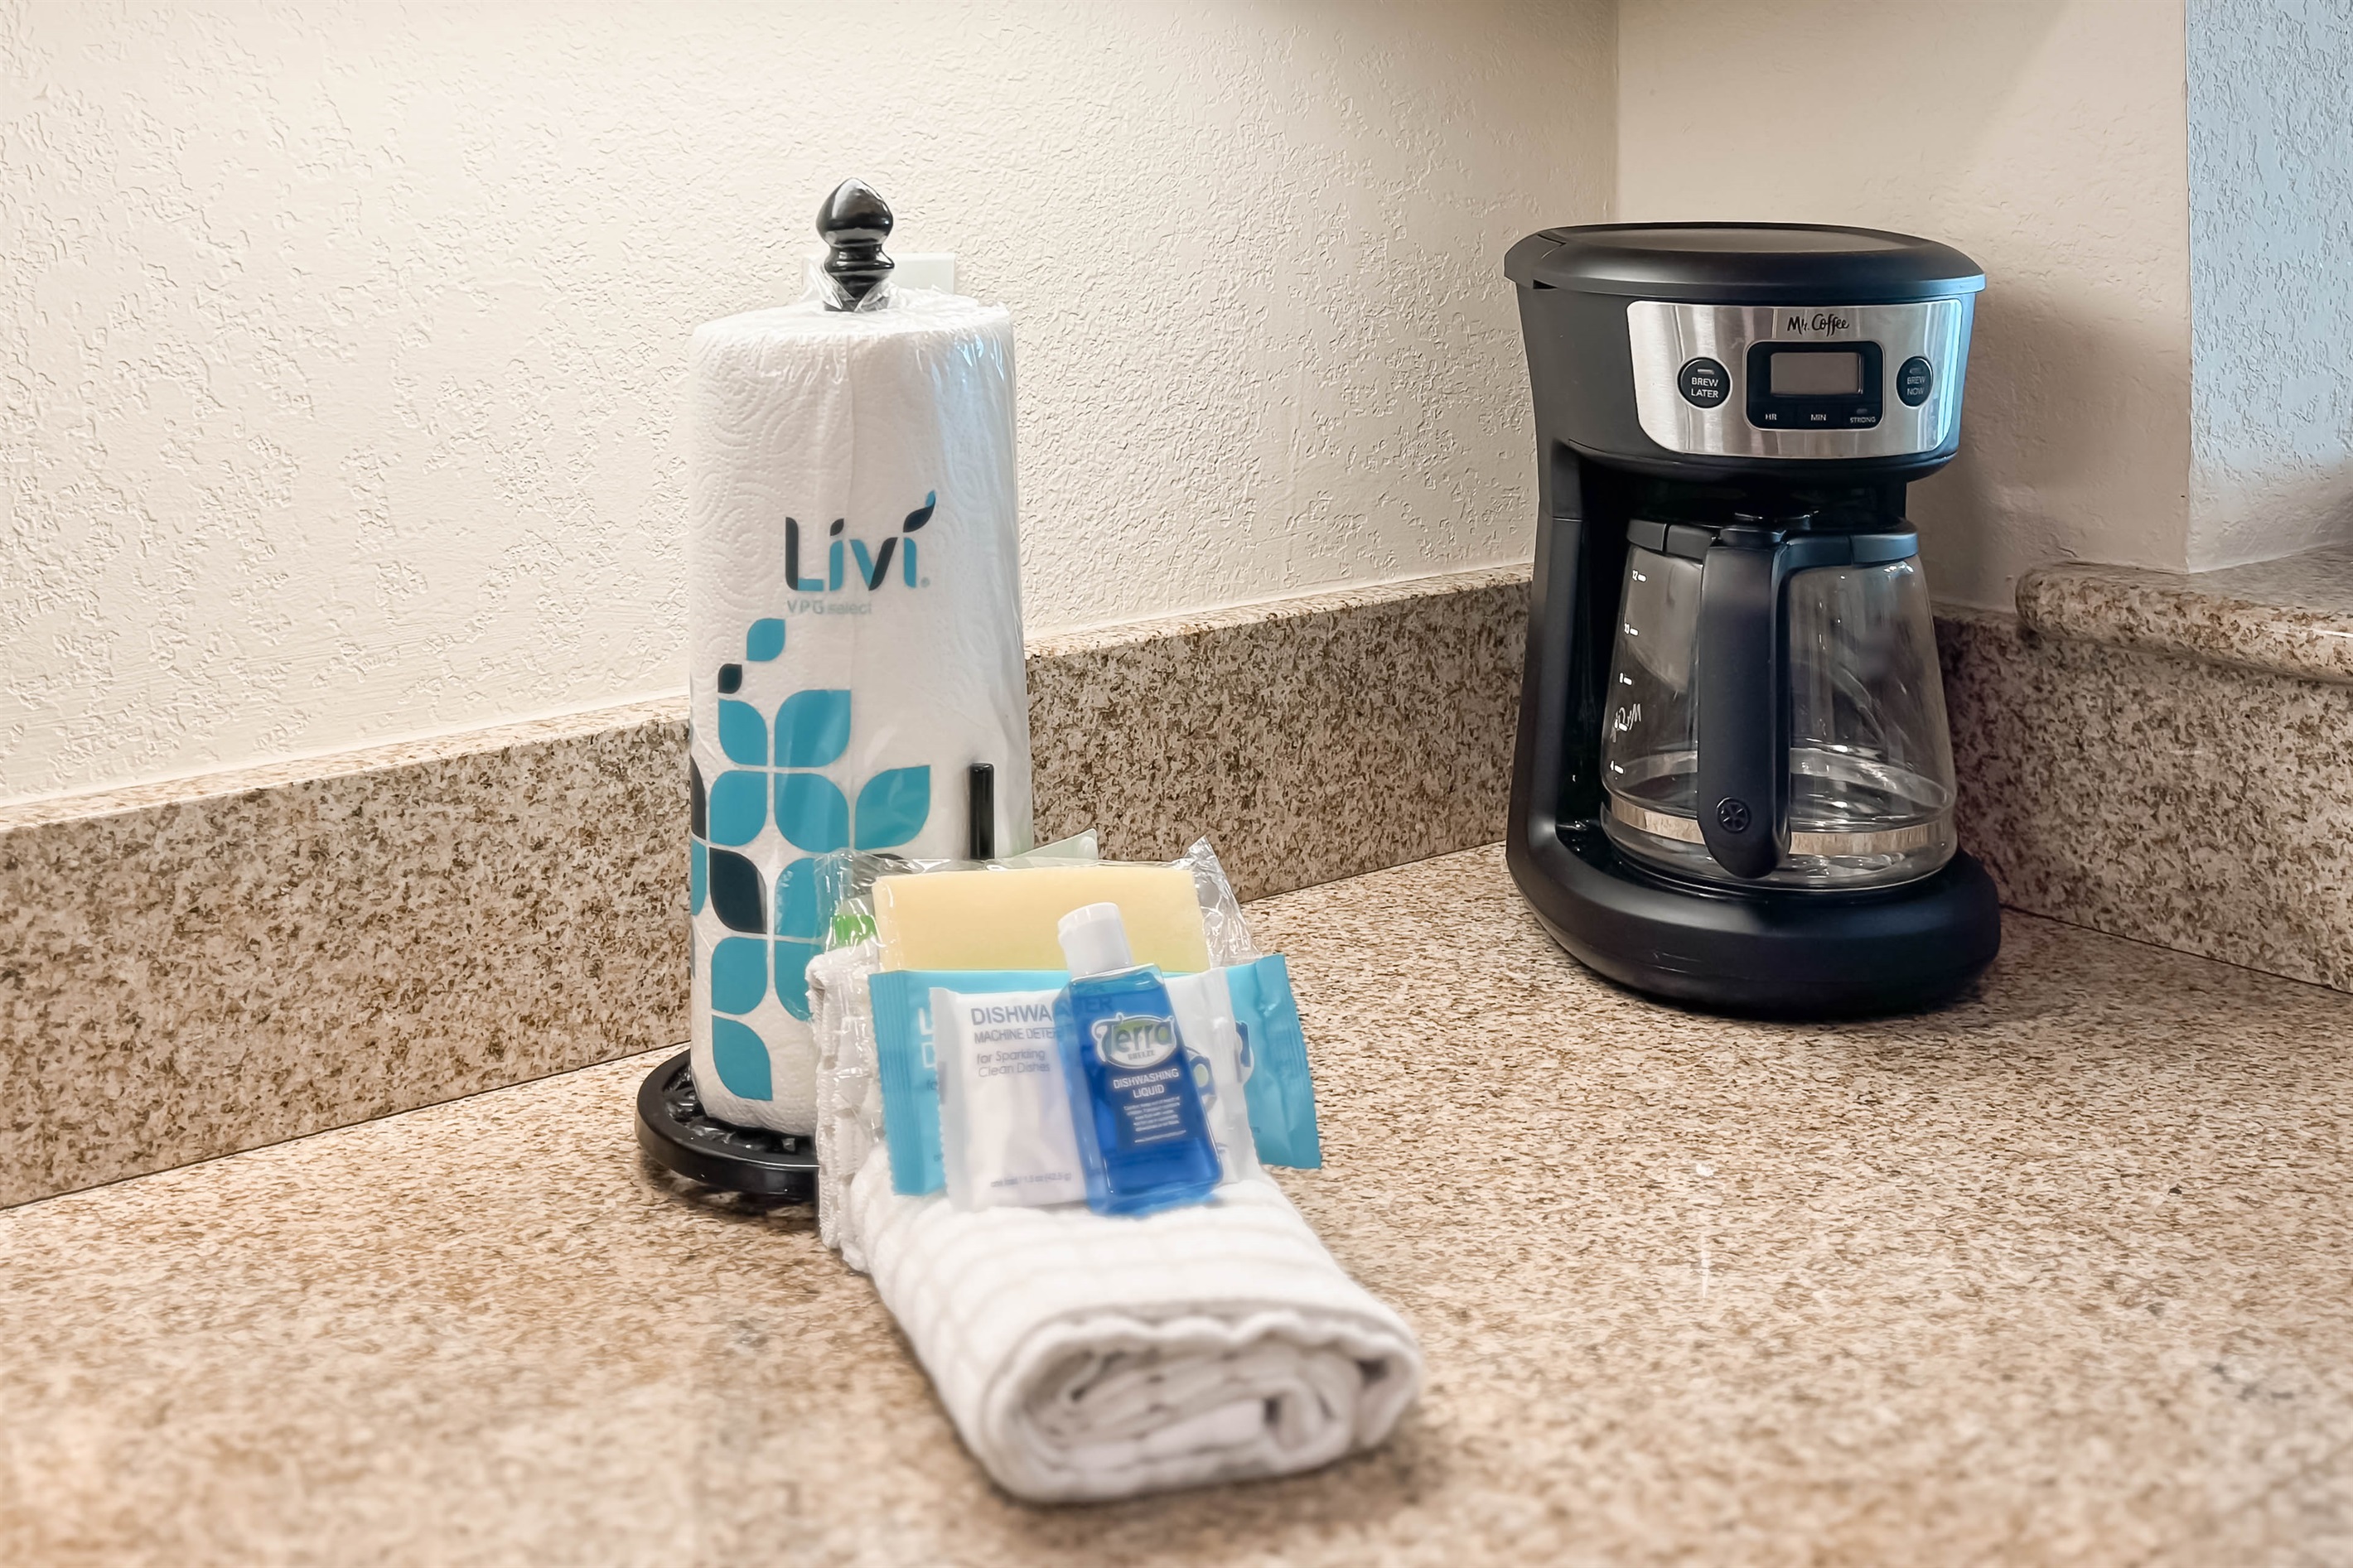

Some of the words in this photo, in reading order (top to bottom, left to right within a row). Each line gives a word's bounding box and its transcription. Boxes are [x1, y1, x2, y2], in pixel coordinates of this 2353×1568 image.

[1787, 316, 1809, 335] Mr.
[1811, 313, 1849, 337] Coffee
[1691, 377, 1719, 387] BREW
[1906, 375, 1926, 385] BREW
[1691, 388, 1719, 398] LATER
[1906, 387, 1925, 396] NOW
[1810, 413, 1827, 422] MIN
[787, 600, 824, 615] VPG
[829, 601, 872, 615] select
[974, 1028, 1025, 1045] MACHINE
[1093, 1013, 1174, 1061] Terra
[976, 1052, 992, 1064] for
[995, 1048, 1046, 1063] Sparkling
[978, 1065, 1014, 1078] Clean
[1017, 1061, 1051, 1073] Dishes
[1113, 1068, 1179, 1089] DISHWASHING
[1133, 1084, 1165, 1098] LIQUID
